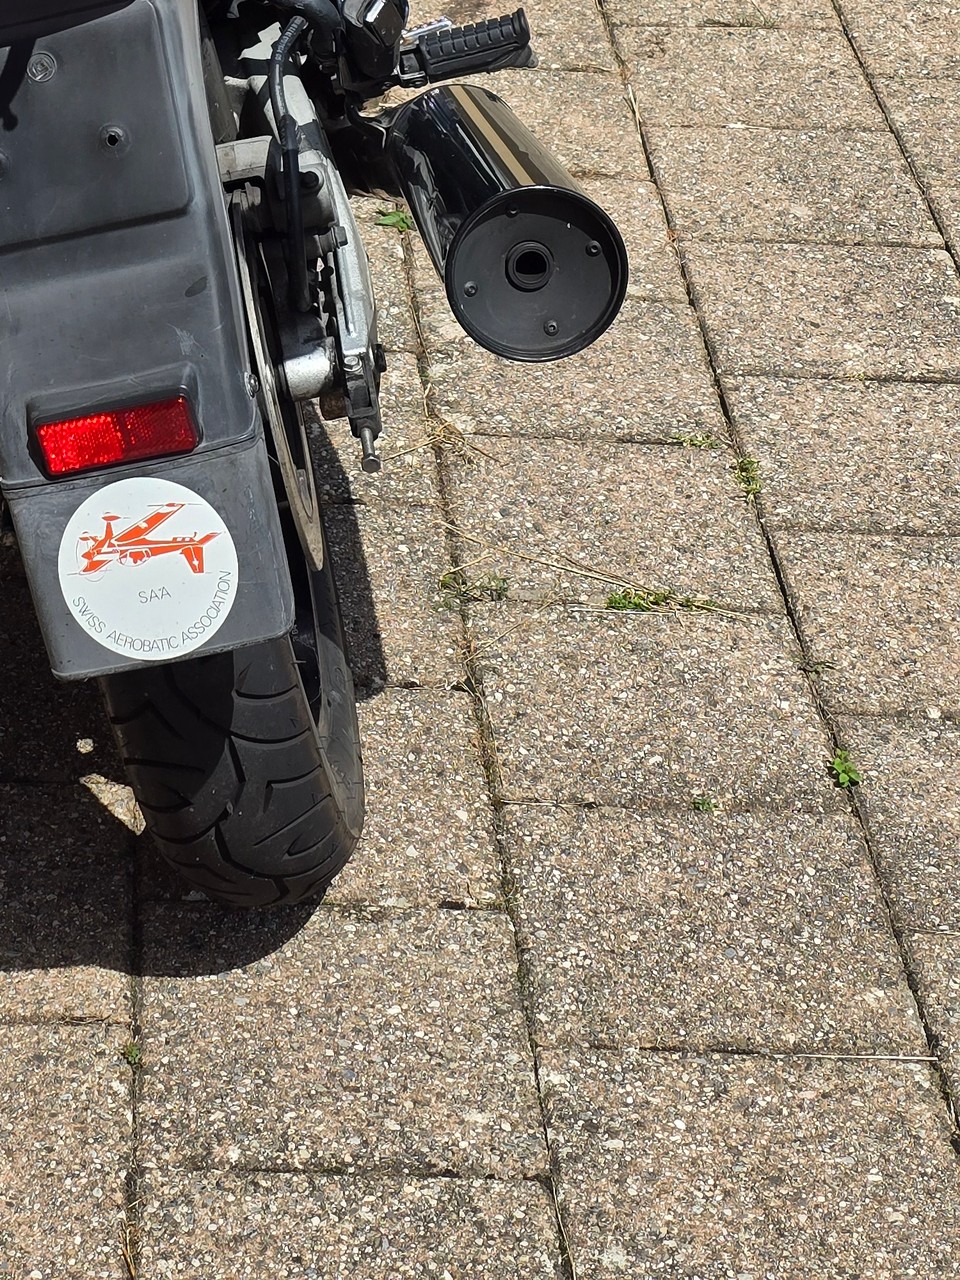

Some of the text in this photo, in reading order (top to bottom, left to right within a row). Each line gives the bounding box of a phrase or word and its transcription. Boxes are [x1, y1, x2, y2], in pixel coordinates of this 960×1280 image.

[72, 570, 232, 653] SWISS AEROBATIC ASSOCIATION
